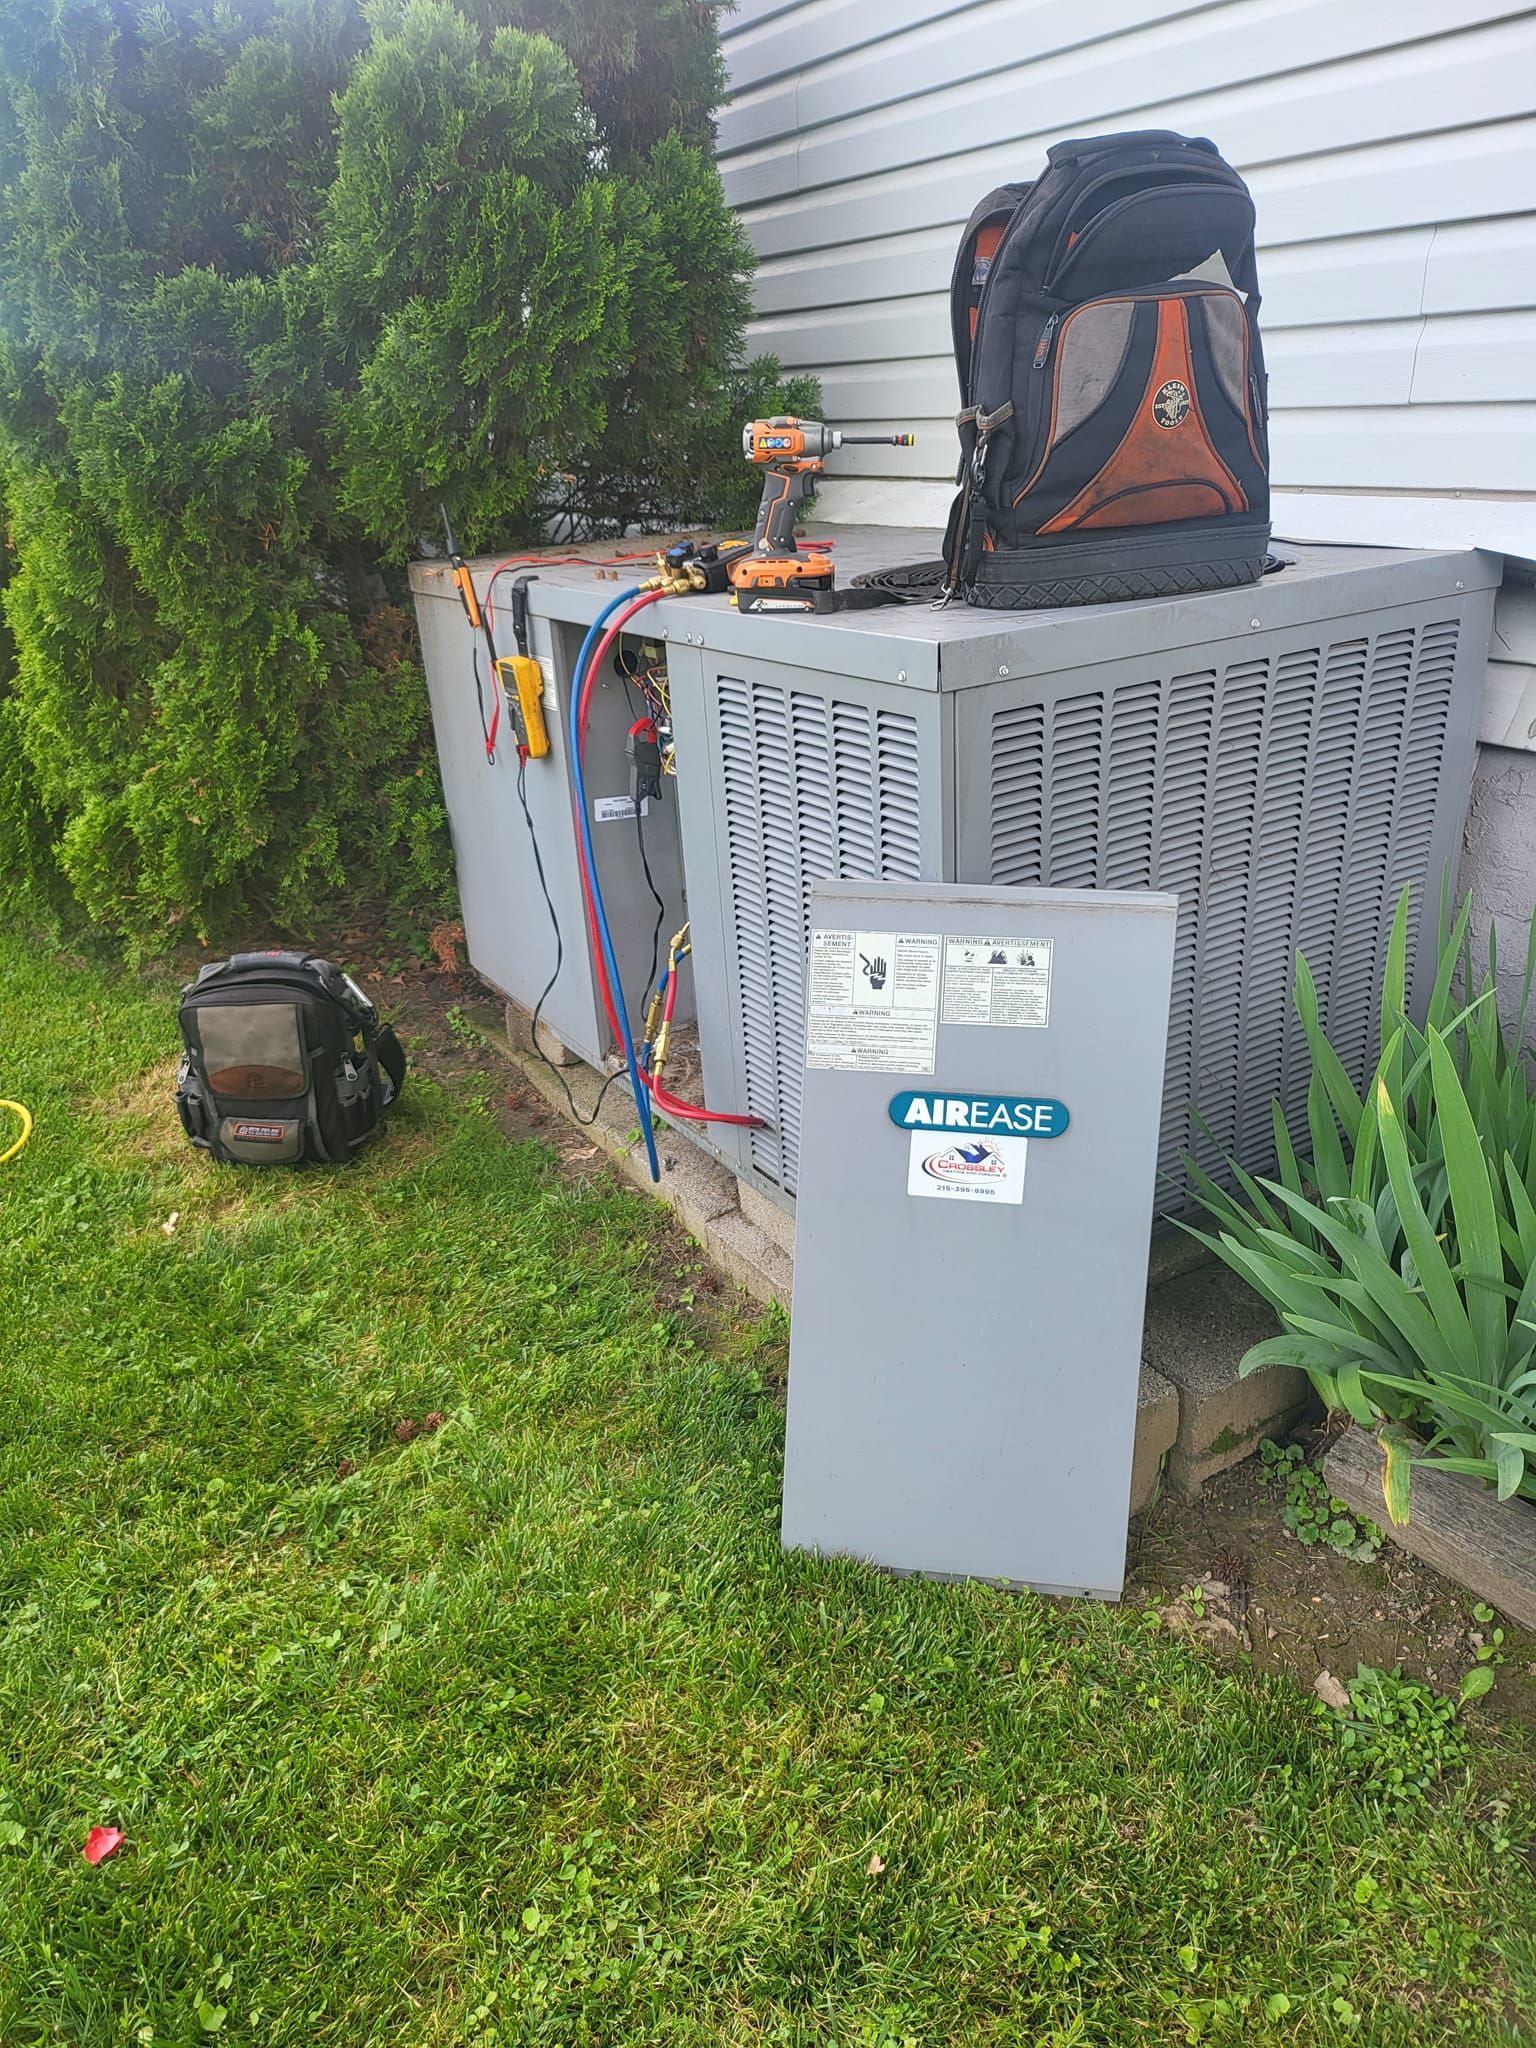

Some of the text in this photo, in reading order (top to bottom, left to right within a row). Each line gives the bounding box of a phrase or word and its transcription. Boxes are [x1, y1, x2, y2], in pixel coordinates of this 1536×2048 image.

[1162, 383, 1185, 394] KLEIN
[1161, 415, 1183, 425] TOOLS
[949, 938, 1050, 948] WARNING AVERTISSEMENT
[858, 1009, 891, 1017] WARNING
[856, 1047, 889, 1055] WARNING
[903, 1098, 1054, 1131] AIREASE
[938, 1160, 1005, 1173] CROSSLEY
